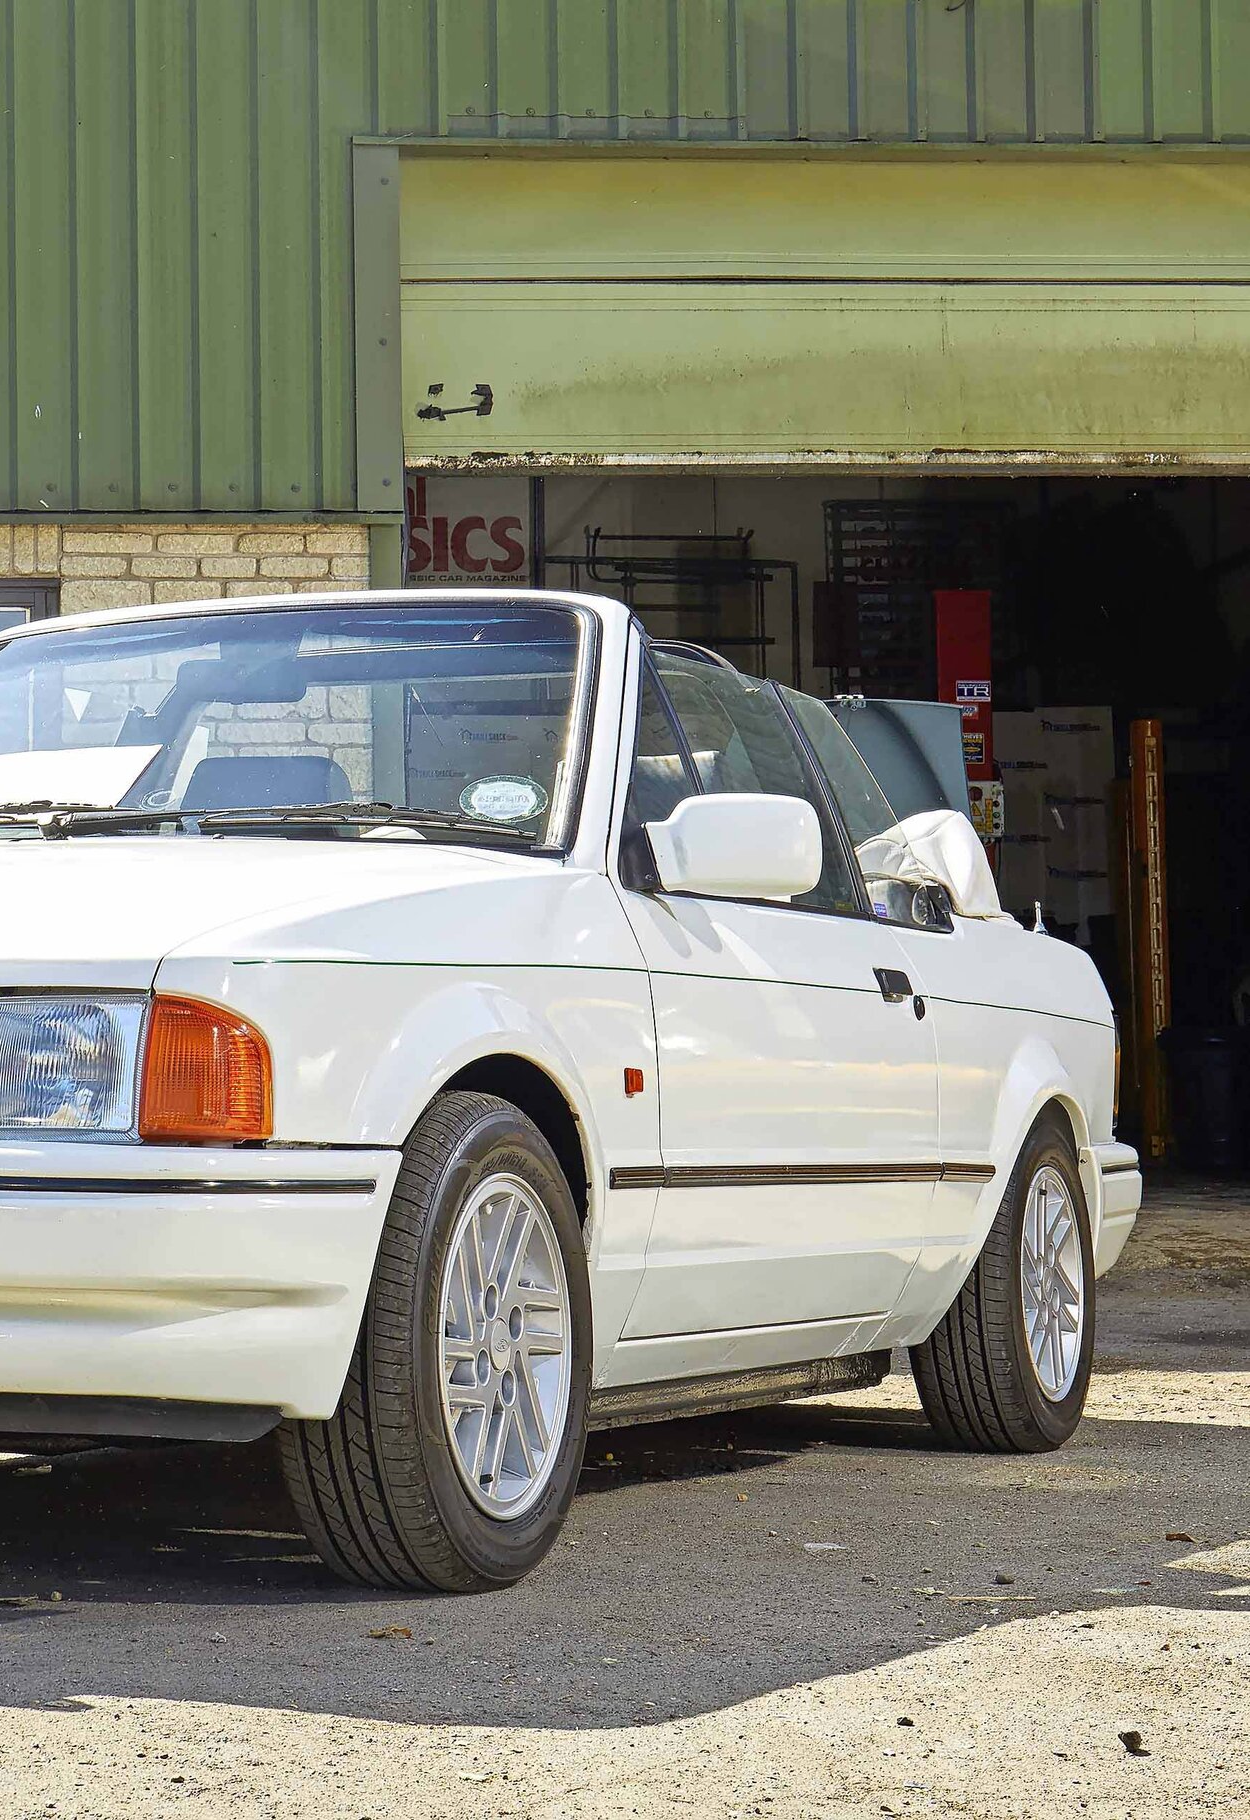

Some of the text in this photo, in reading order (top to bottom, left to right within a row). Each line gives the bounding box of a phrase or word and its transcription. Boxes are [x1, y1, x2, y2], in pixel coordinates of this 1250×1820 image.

[438, 574, 463, 582] CAR
[467, 574, 527, 582] MAGAZINE
[958, 686, 990, 696] TR
